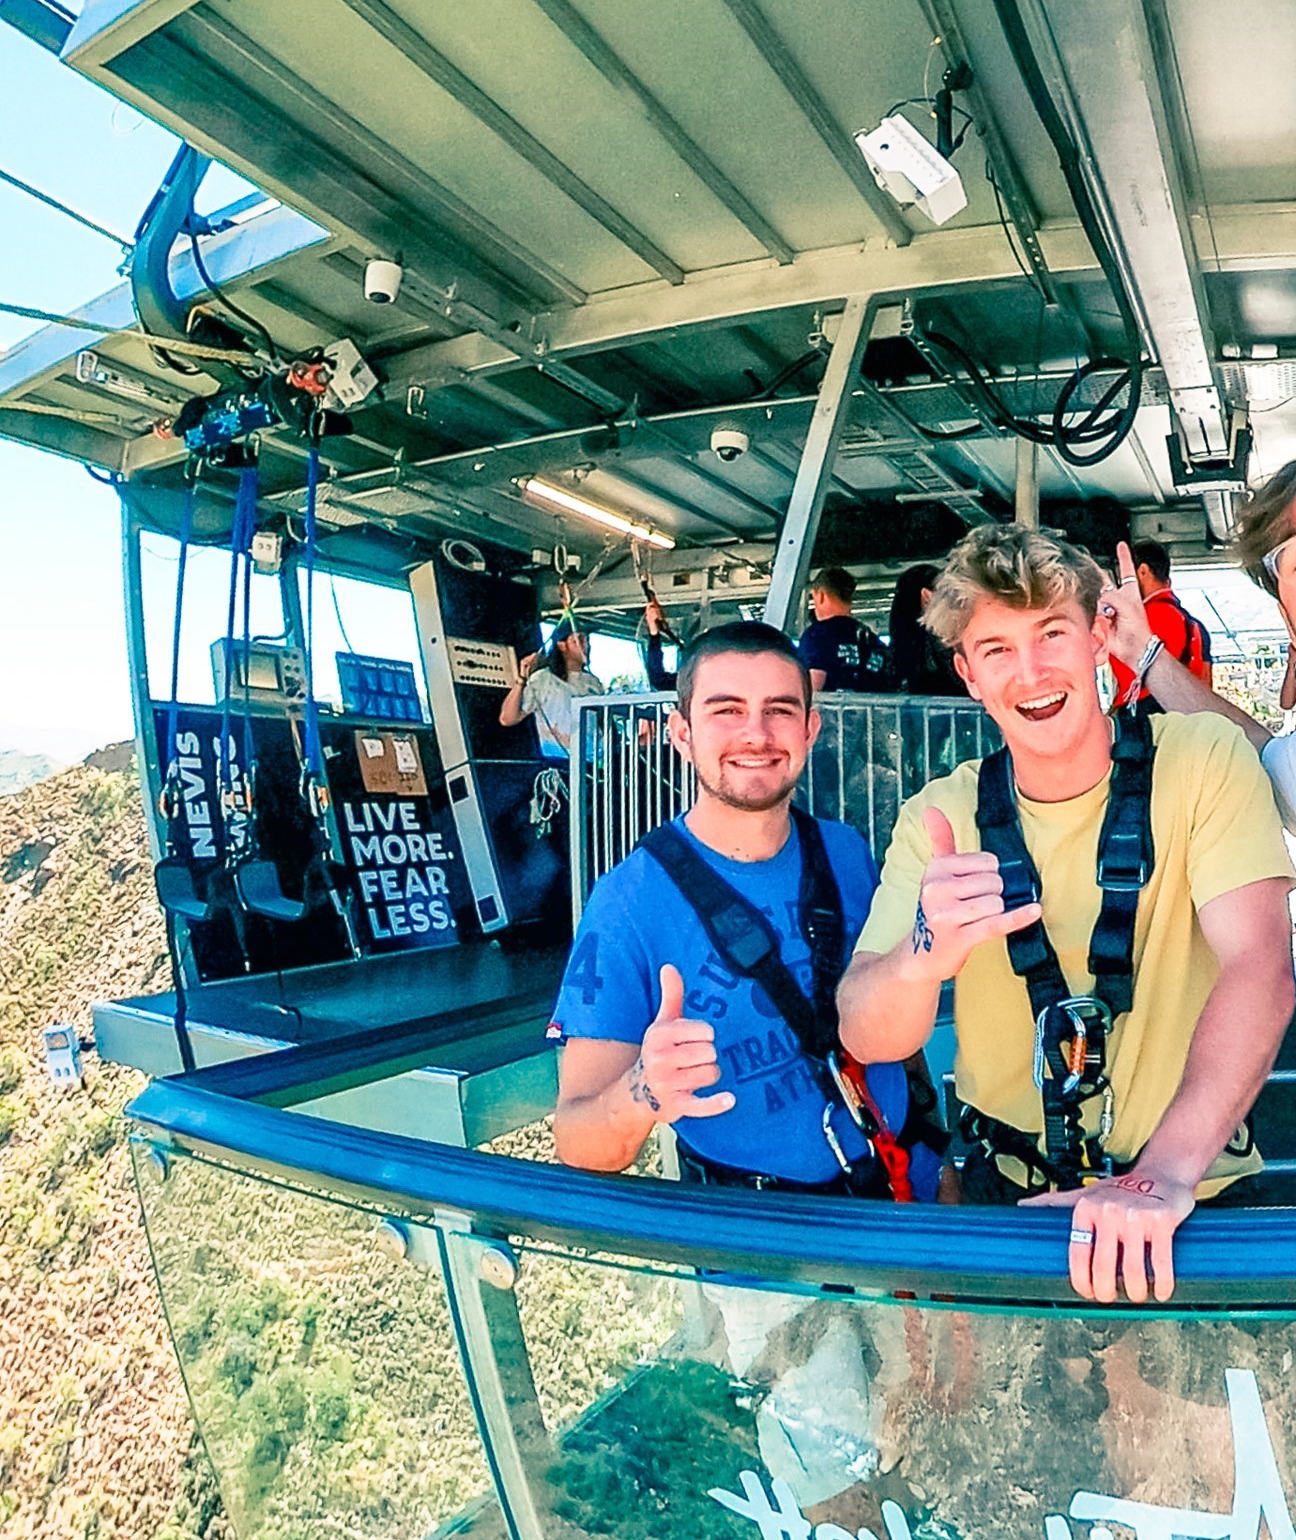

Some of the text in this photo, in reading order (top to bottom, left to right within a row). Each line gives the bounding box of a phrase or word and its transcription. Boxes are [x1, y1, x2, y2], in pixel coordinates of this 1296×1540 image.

[175, 731, 217, 858] NEVIS
[343, 802, 420, 832] LIVE
[350, 833, 454, 866] MORE.
[358, 866, 450, 902] FEAR
[367, 900, 456, 939] LESS.
[562, 931, 604, 1005] 4
